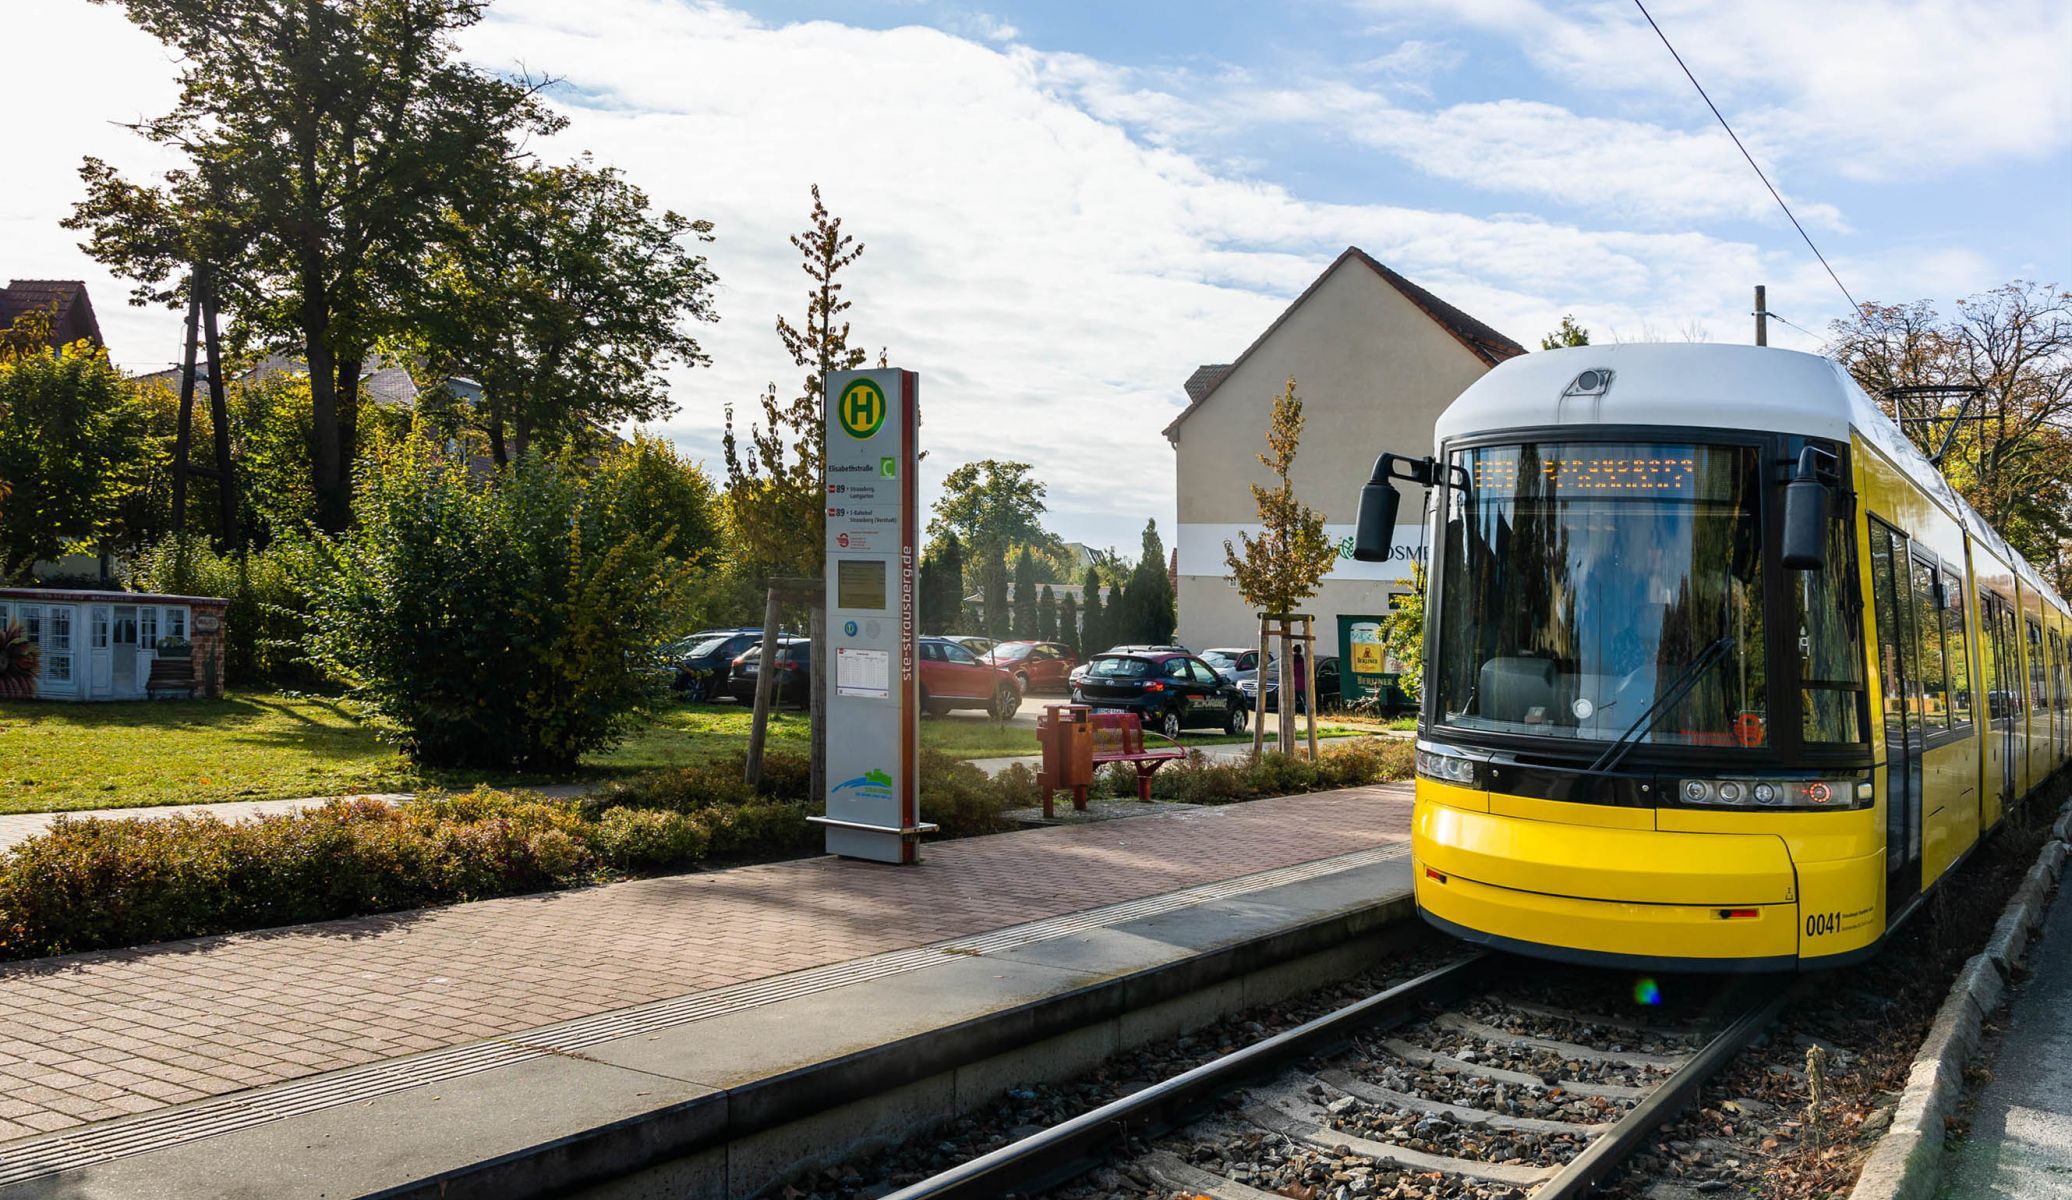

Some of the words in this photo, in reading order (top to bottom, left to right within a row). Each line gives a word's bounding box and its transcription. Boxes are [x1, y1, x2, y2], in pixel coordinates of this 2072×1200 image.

[850, 391, 873, 425] H
[828, 464, 874, 473] Elisabethstraße
[836, 484, 846, 494] 89
[836, 508, 846, 517] 89
[902, 546, 913, 681] ste-strausberg.de
[1806, 912, 1840, 937] 0041
